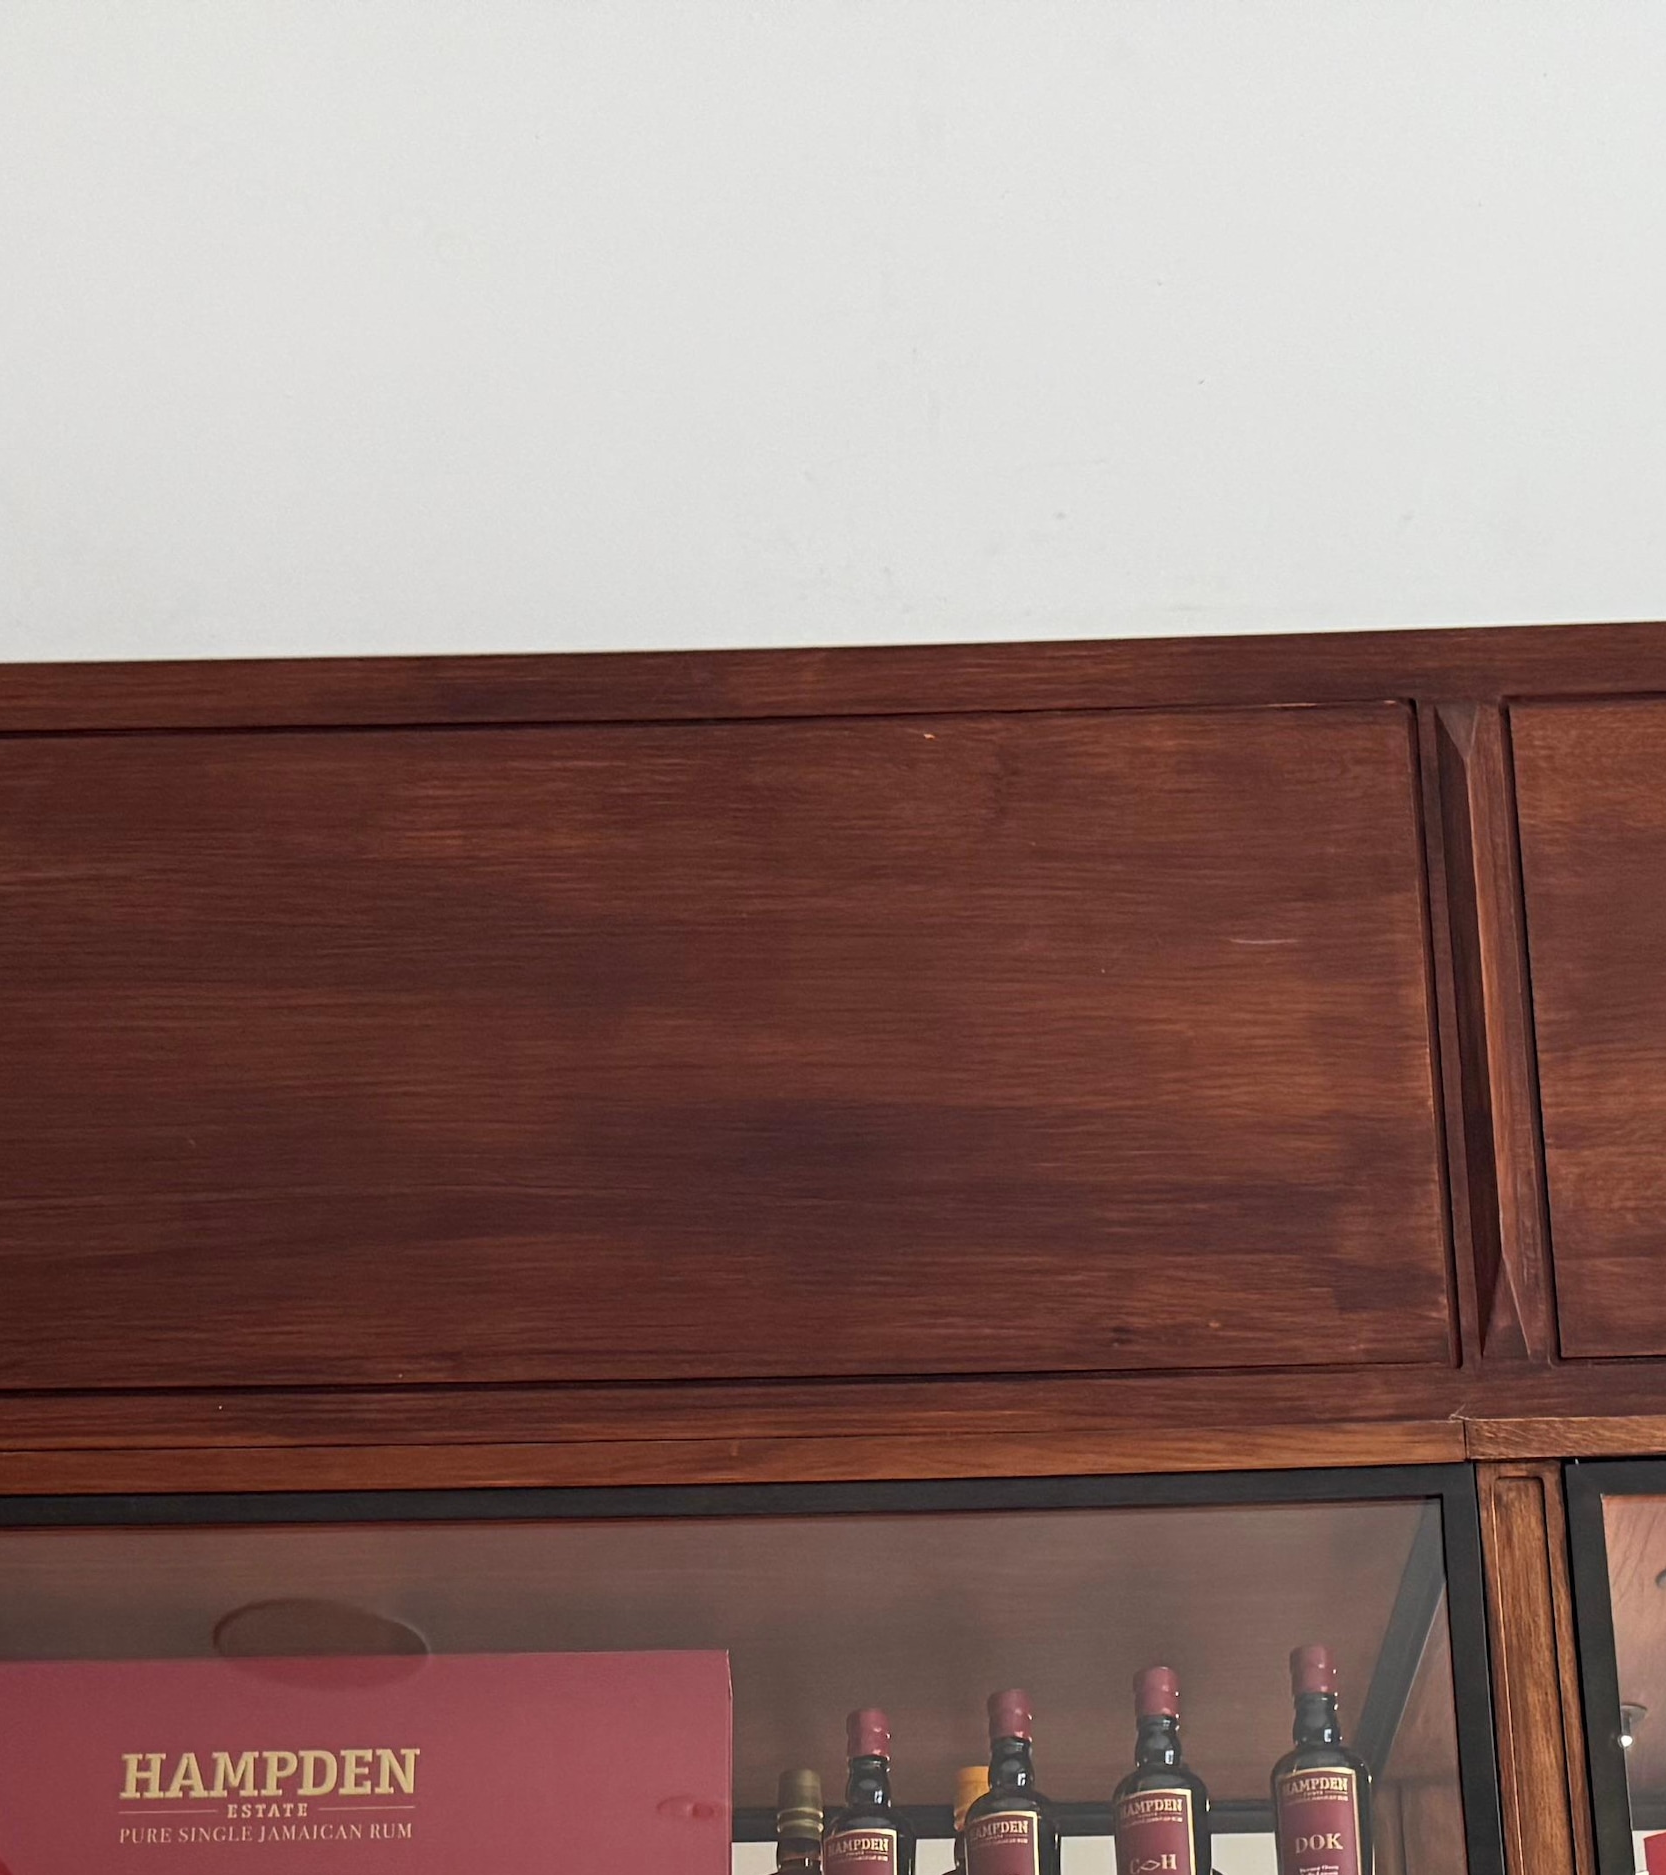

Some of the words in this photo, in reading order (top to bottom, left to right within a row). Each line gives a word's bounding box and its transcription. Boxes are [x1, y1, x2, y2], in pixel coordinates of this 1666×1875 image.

[119, 1748, 421, 1799] HAMPDEN
[227, 1803, 309, 1819] ESTATE
[119, 1827, 172, 1843] PURE
[178, 1826, 253, 1842] SINGLE
[258, 1823, 363, 1842] JAMAICAN
[369, 1822, 413, 1840] RUM
[1295, 1832, 1344, 1854] DOK
